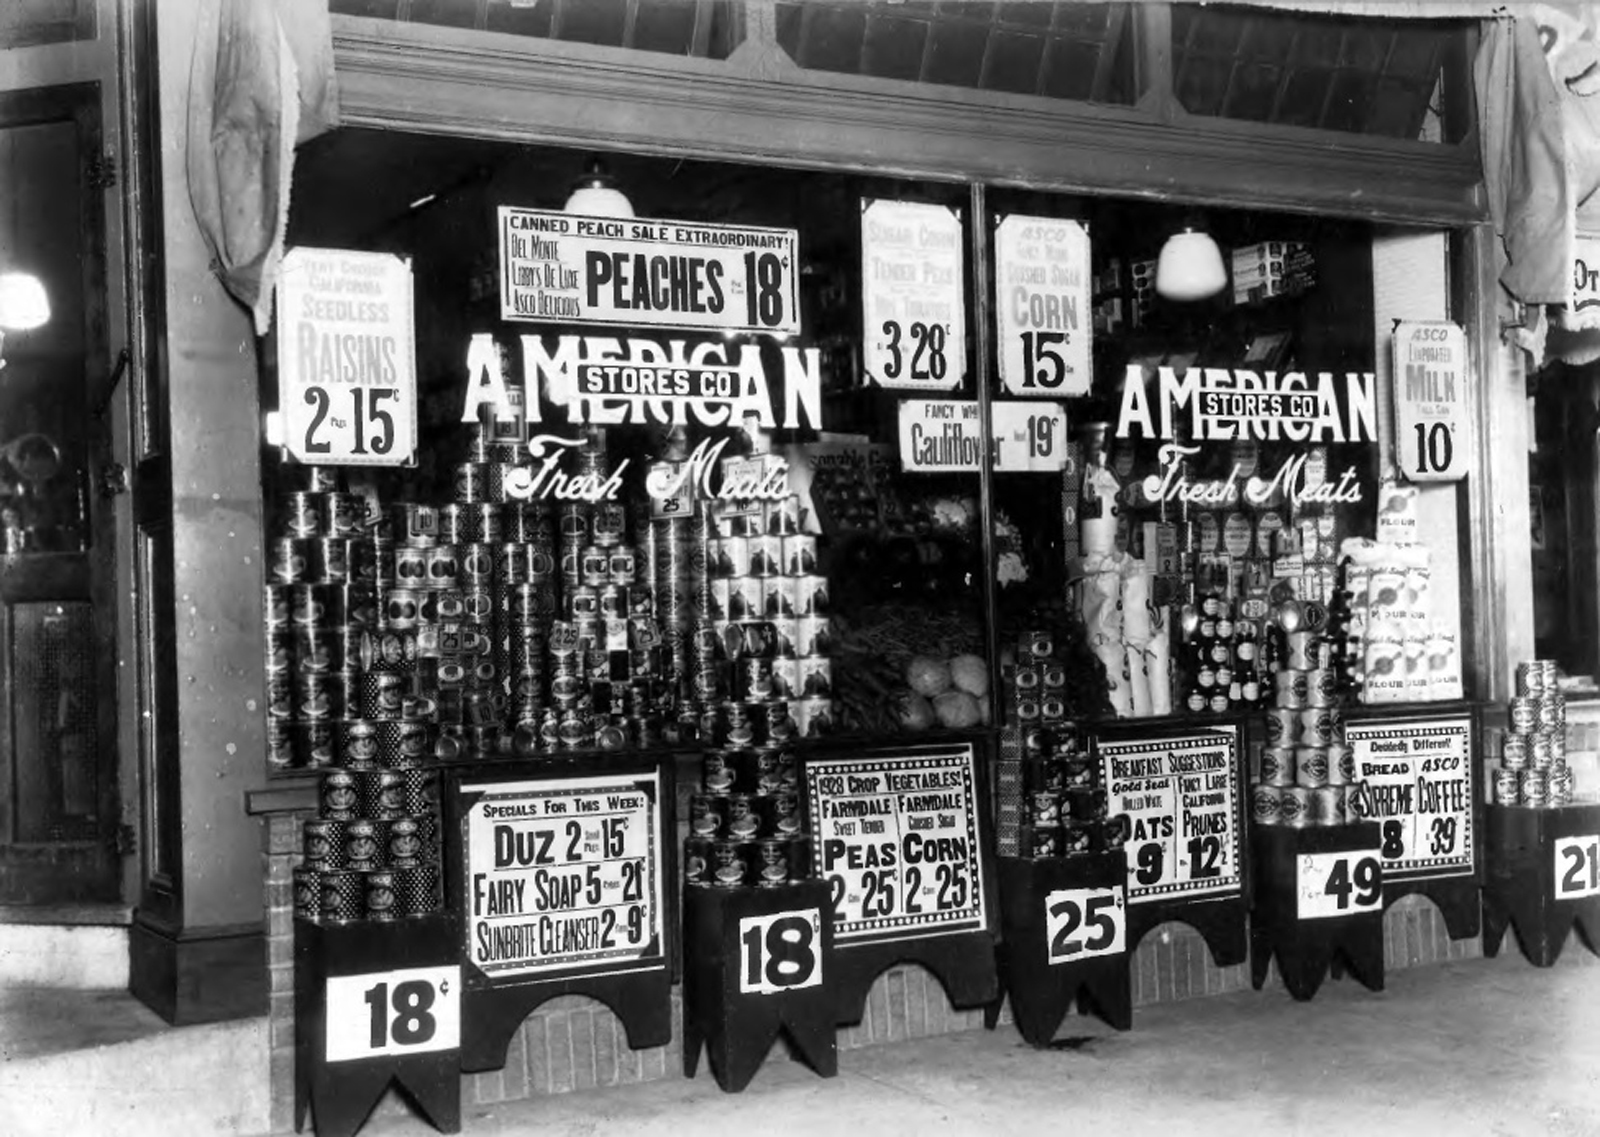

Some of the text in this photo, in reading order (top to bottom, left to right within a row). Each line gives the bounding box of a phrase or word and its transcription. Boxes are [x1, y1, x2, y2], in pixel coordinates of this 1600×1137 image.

[510, 215, 789, 249] CANNED PEACH SALE EXTRAORDINARY!
[530, 235, 559, 261] MONTE
[586, 250, 724, 314] PEACHES
[302, 293, 390, 323] SEEDLESS
[513, 288, 536, 315] ASCO
[1013, 285, 1078, 331] CORN
[298, 321, 397, 385] RAISINS
[882, 320, 902, 379] 3
[1411, 328, 1448, 342] ASCO
[460, 333, 822, 430] AMERICAN
[587, 367, 731, 397] STORES CO
[1405, 364, 1456, 402] MILK
[304, 386, 331, 453] 2
[925, 403, 955, 419] FANCY
[1115, 364, 1378, 442] AMERICAN
[1206, 393, 1314, 417] STORES CO
[505, 434, 630, 500] Fresh
[646, 436, 796, 501] Meats
[1143, 443, 1363, 508] Fresh Meats
[1111, 751, 1227, 779] BREAKFAST SUGGESTIONS
[1361, 762, 1410, 777] BREAD
[1421, 757, 1460, 773] ASCO
[818, 776, 844, 796] 1928
[847, 774, 880, 794] CROP
[898, 793, 962, 813] FARMDALE
[1112, 778, 1170, 796] Gold Seal
[1359, 779, 1415, 818] SUPREME
[1417, 776, 1465, 814] COFFEE
[483, 802, 537, 818] SPECIALS
[544, 800, 567, 814] FOR
[573, 798, 600, 813] THIS
[822, 798, 892, 819] FARMDALE
[1182, 809, 1227, 837] PRUNES
[494, 824, 555, 868] DUZ
[565, 820, 583, 862] 2
[823, 838, 897, 872] PEAS
[902, 832, 968, 865] CORN
[473, 872, 526, 916] FAIRY
[534, 868, 582, 911] SOAP
[586, 864, 601, 905] 5
[830, 874, 847, 921] 2
[905, 866, 922, 914] 2
[1324, 856, 1383, 909] 49
[477, 920, 537, 962] SUNBRITE
[538, 915, 599, 956] CLEANSER
[600, 908, 616, 949] 2
[364, 977, 449, 1049] 18¢
